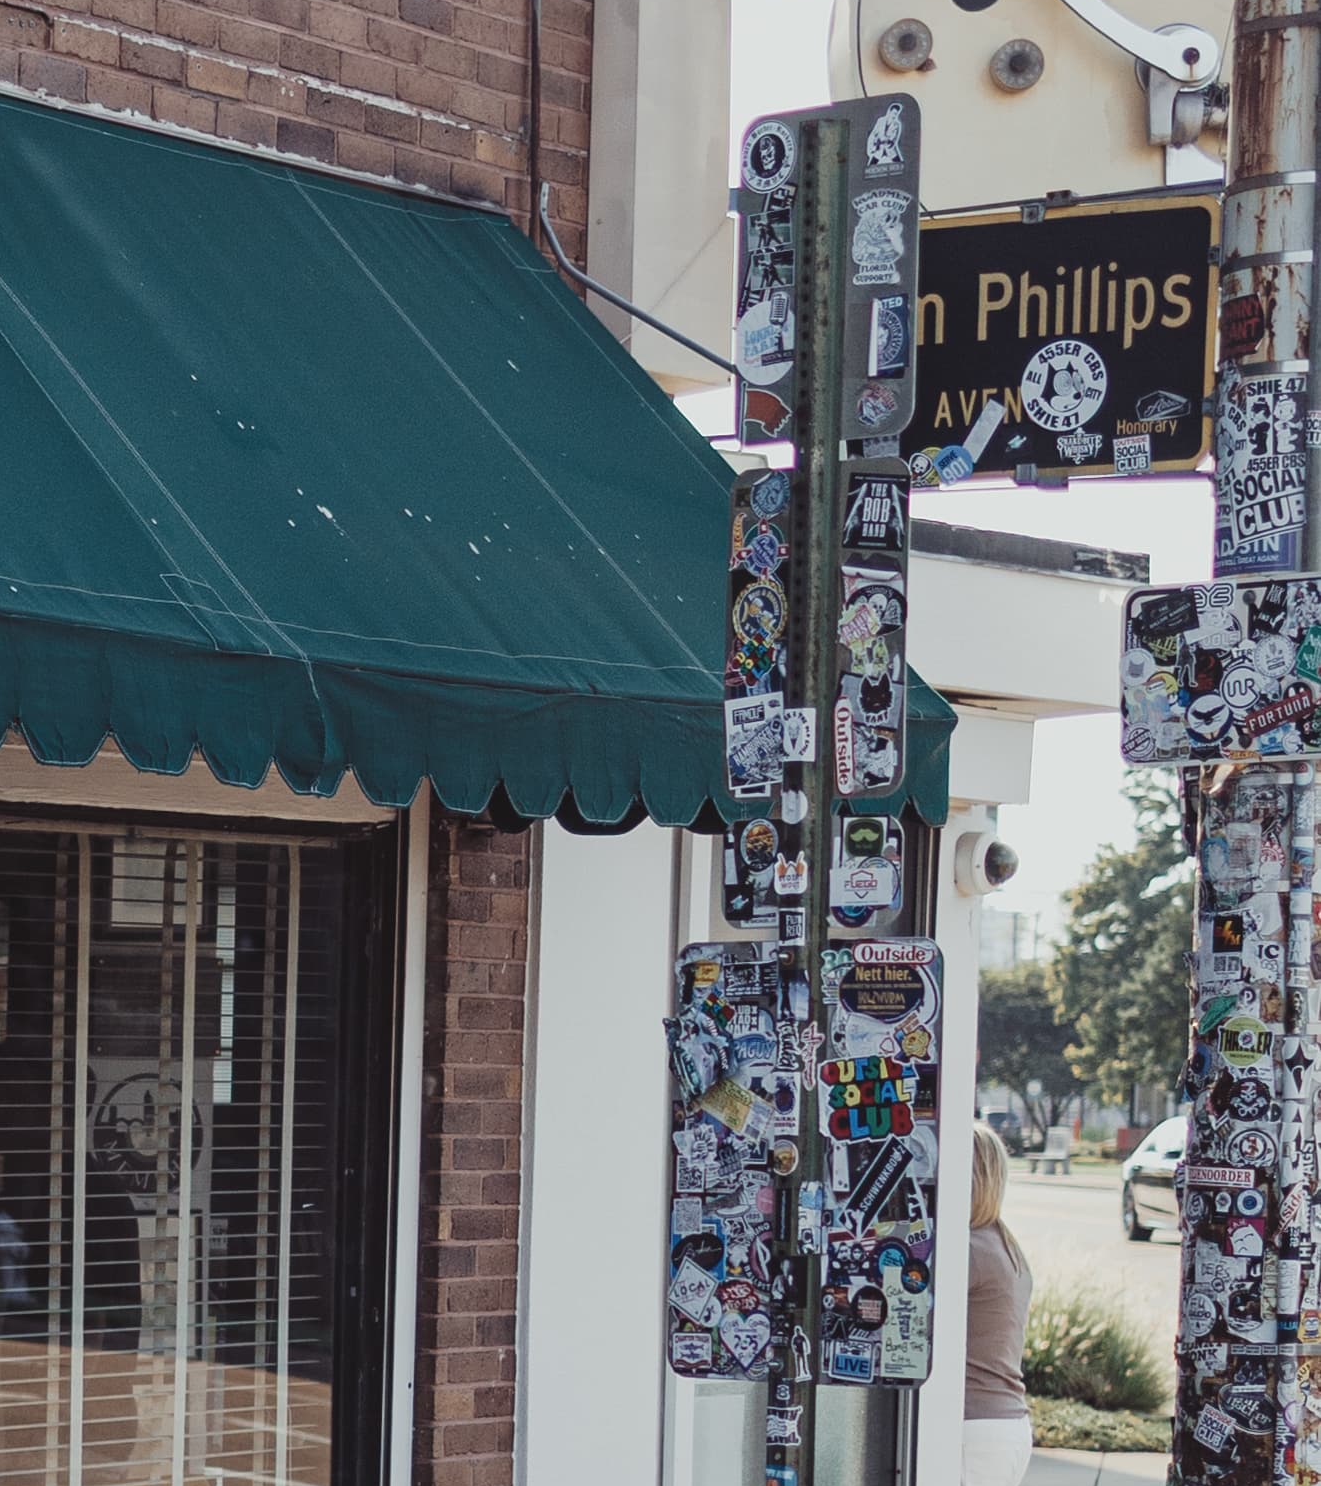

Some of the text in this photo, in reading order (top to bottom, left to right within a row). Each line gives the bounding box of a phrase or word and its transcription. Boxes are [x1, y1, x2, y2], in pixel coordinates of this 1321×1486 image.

[859, 202, 878, 214] CAR
[977, 262, 1192, 350] Phillips
[1038, 342, 1105, 382] 455ER CBS
[1026, 370, 1042, 385] ALL
[1246, 377, 1305, 395] SHIE 47
[1084, 387, 1103, 401] CITY
[1027, 398, 1080, 428] SHIE 47
[1116, 418, 1177, 436] Honorary
[1116, 445, 1148, 458] SOCIAL
[942, 456, 969, 484] 901
[1117, 457, 1148, 472] CLUB
[871, 483, 888, 497] THE
[1233, 468, 1305, 504] SOCIAL
[862, 497, 891, 523] BOB
[1238, 493, 1305, 536] CLUB
[1248, 695, 1311, 732] FORTUNA
[837, 704, 849, 787] Outside
[844, 879, 878, 891] FUEGO
[861, 945, 926, 962] Outside
[855, 965, 912, 981] Nett hier.
[821, 1059, 914, 1085] OUTSIDE
[829, 1077, 911, 1106] SOCIAL
[829, 1103, 914, 1140] CLUB
[672, 1280, 710, 1299] LOCAL
[835, 1354, 869, 1372] LIVE
[1201, 1415, 1227, 1436] SOCIAL
[1197, 1426, 1222, 1446] CLUB
